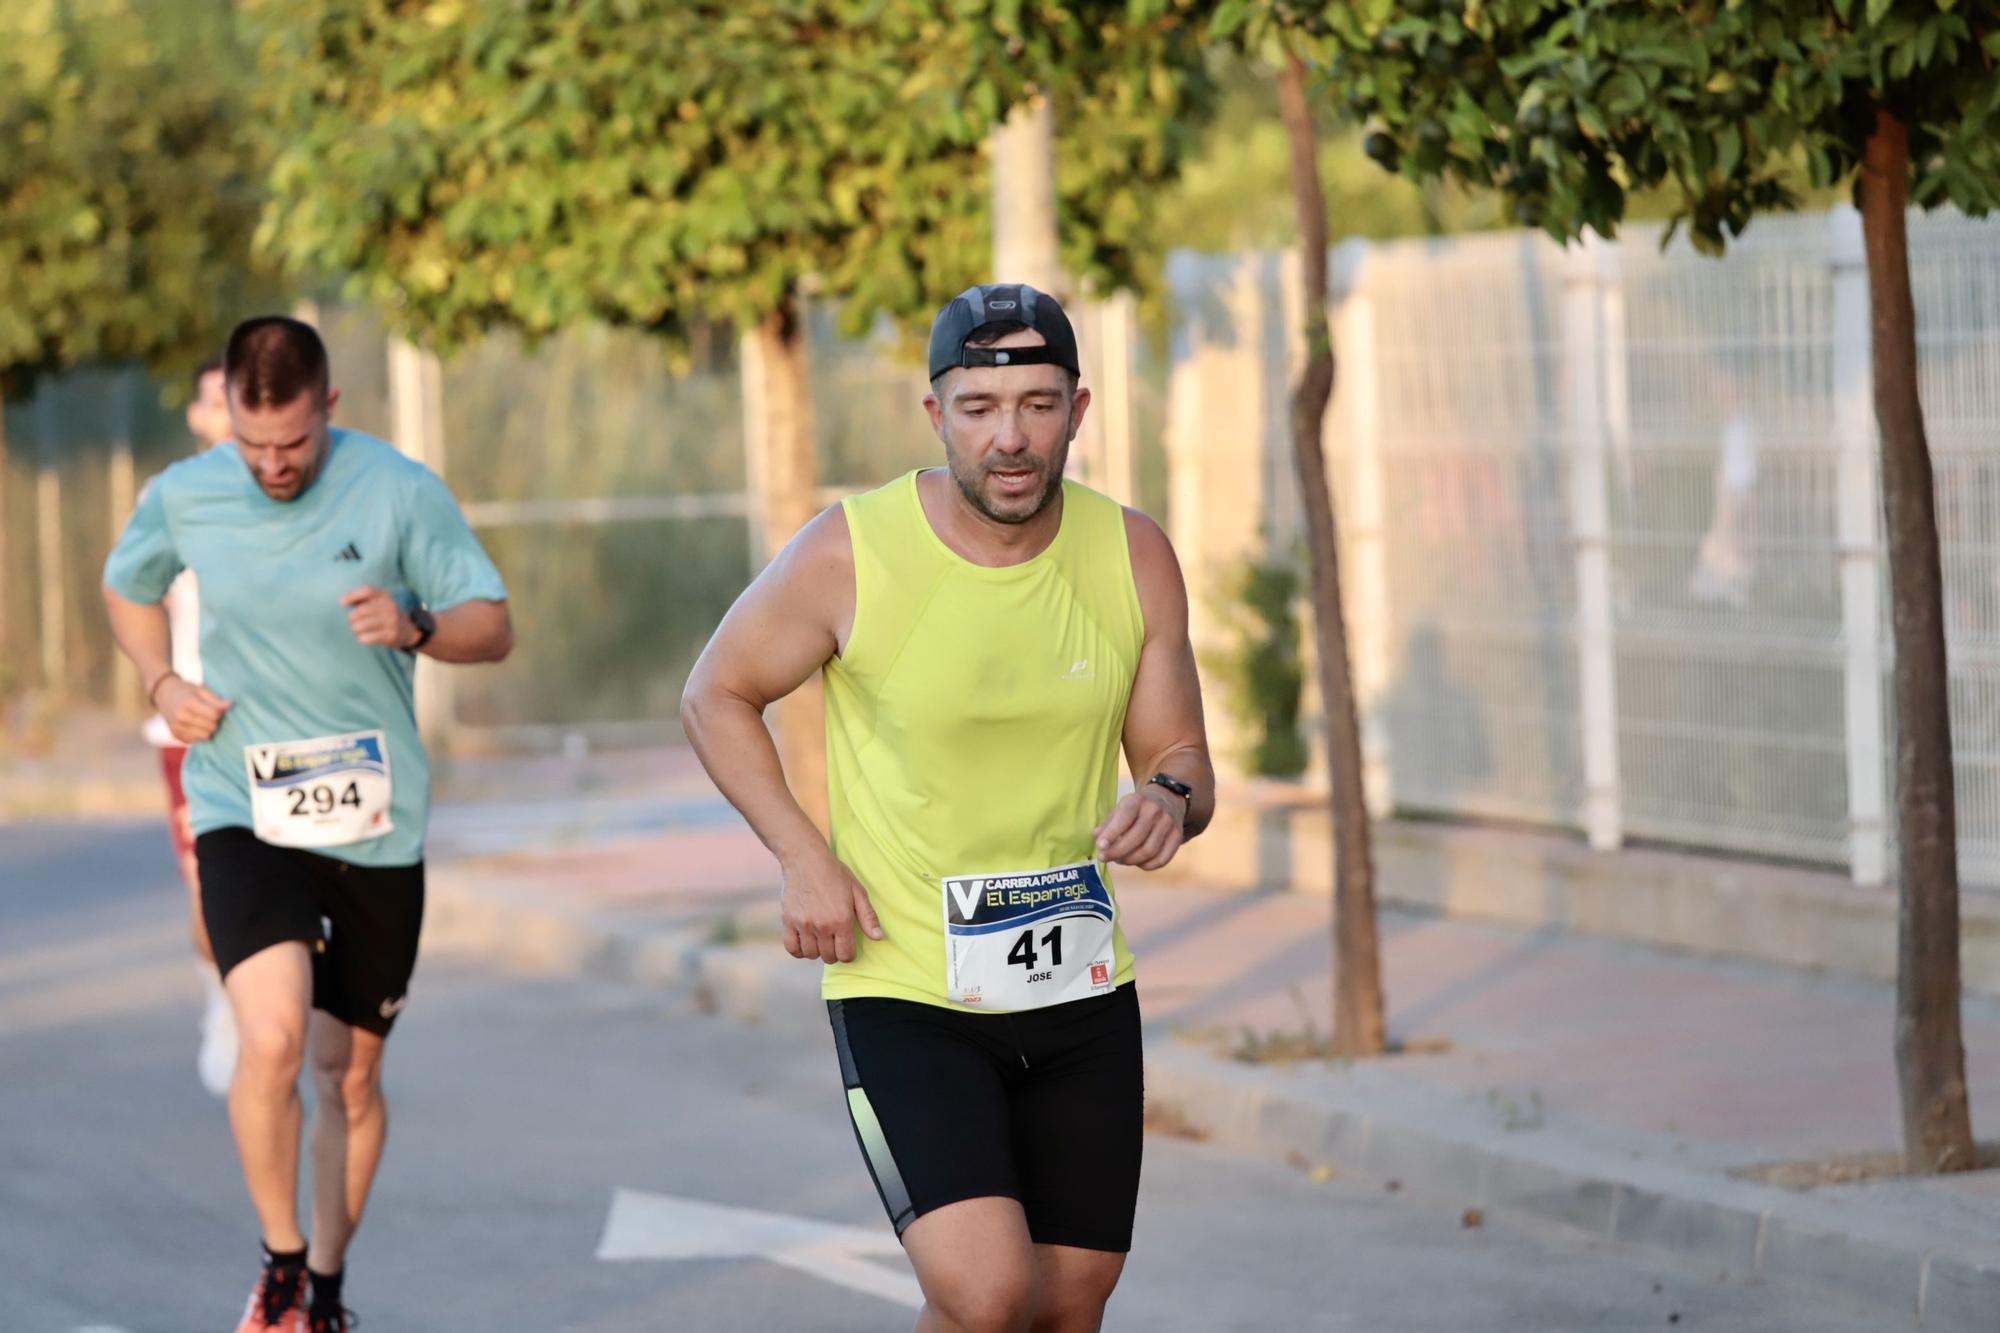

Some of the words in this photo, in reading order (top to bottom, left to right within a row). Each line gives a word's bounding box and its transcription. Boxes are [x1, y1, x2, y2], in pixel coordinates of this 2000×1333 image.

[287, 780, 362, 816] 294
[985, 876, 1041, 890] CARRERA
[1041, 869, 1079, 886] POPULAR
[948, 880, 984, 920] V
[986, 891, 1006, 907] El
[1007, 925, 1063, 970] 41
[1026, 971, 1052, 984] JOSE
